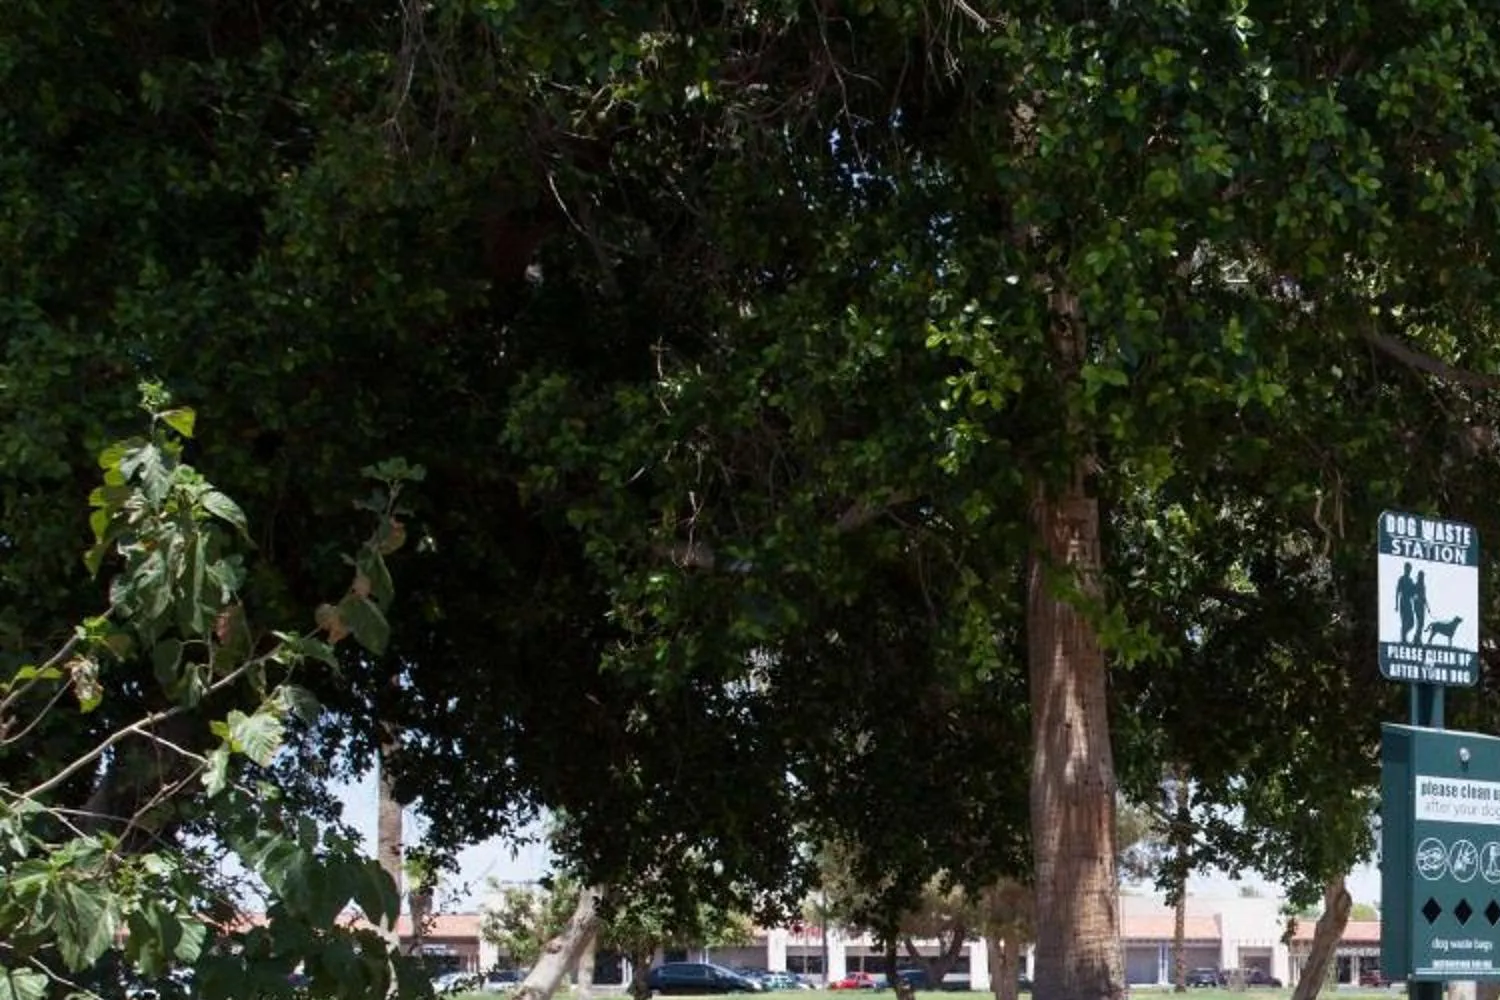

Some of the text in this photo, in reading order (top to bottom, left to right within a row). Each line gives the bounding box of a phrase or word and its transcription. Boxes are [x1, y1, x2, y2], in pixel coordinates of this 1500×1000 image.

[1386, 514, 1471, 545] DOG WASTE
[1391, 539, 1466, 565] STATION
[1387, 645, 1471, 667] PLEASE CLEAN UP
[1389, 663, 1419, 679] AFTER
[1421, 780, 1458, 798] please
[1460, 783, 1491, 800] clean
[1424, 801, 1449, 814] after
[1452, 804, 1478, 816] your
